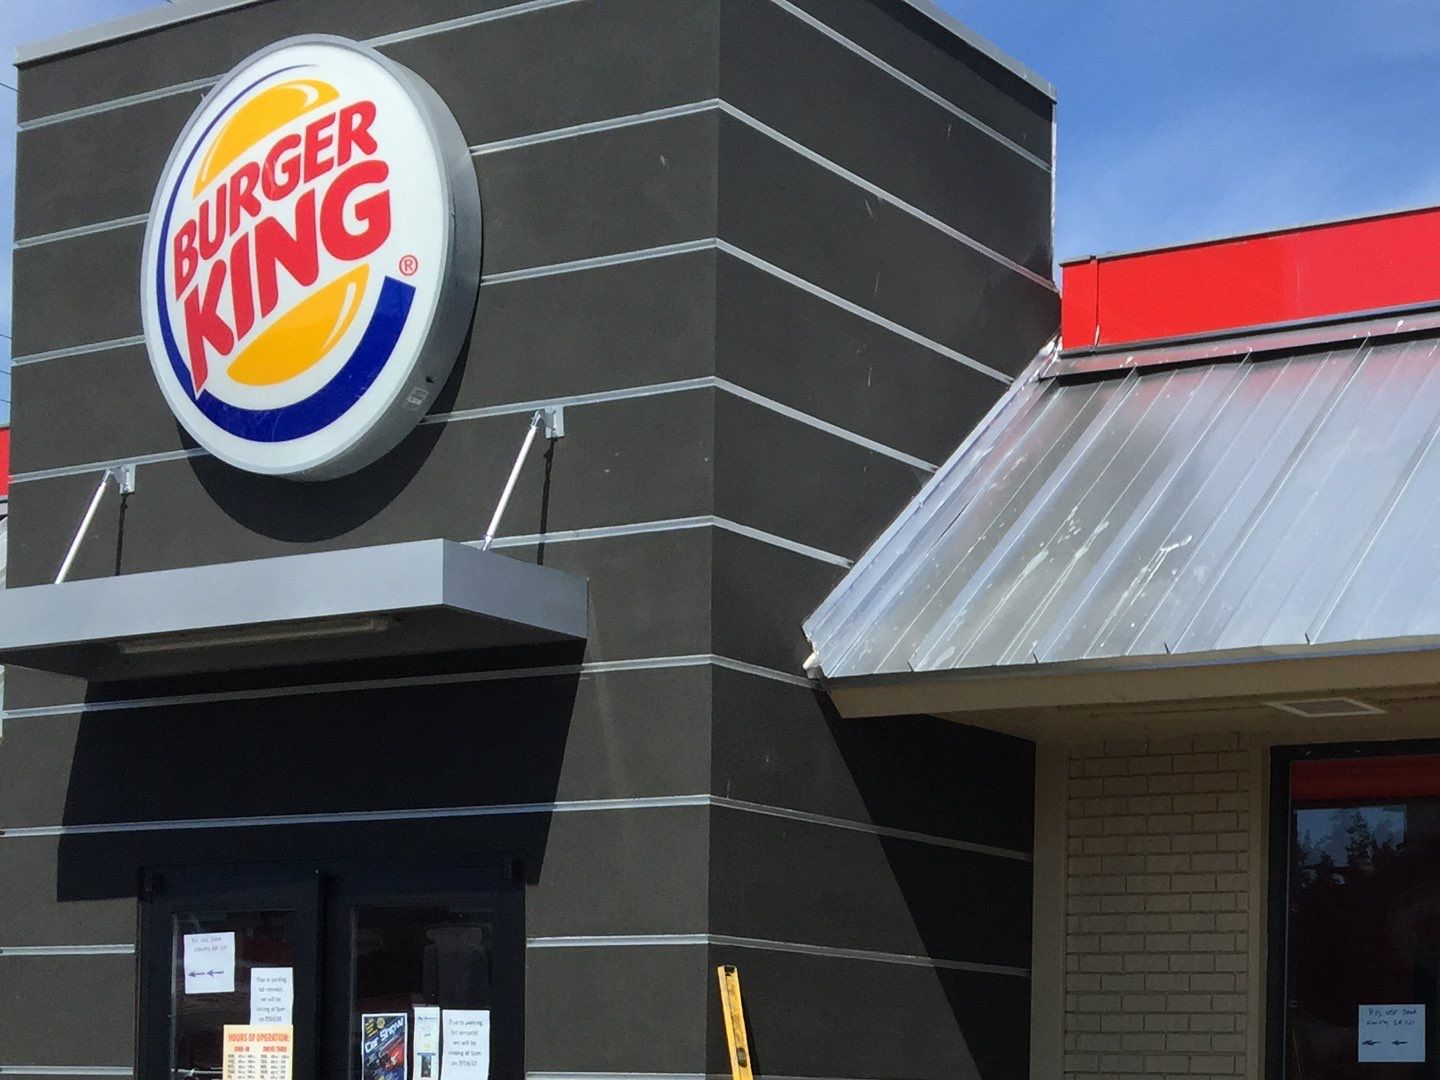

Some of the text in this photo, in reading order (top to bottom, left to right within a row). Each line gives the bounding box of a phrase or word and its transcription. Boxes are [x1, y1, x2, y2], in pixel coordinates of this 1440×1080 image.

[174, 100, 378, 300] BURGER
[184, 159, 391, 396] KING
[228, 1033, 248, 1042] HOURS
[249, 1033, 256, 1042] OF
[365, 1037, 379, 1053] Car
[380, 1017, 404, 1041] Show
